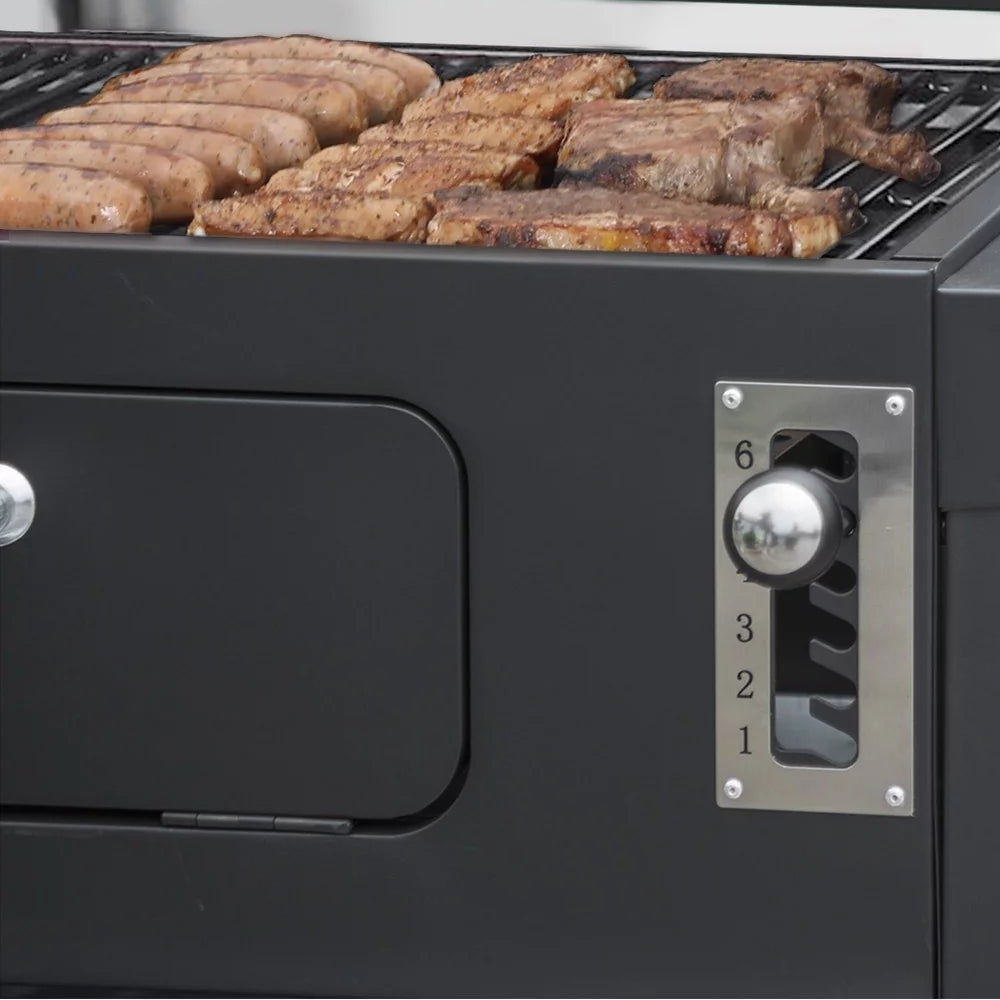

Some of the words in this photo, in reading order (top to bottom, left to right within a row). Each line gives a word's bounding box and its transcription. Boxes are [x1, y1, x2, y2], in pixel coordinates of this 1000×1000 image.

[735, 440, 754, 470] 6
[736, 613, 754, 643] 3
[736, 670, 754, 699] 2
[738, 726, 752, 755] 1
